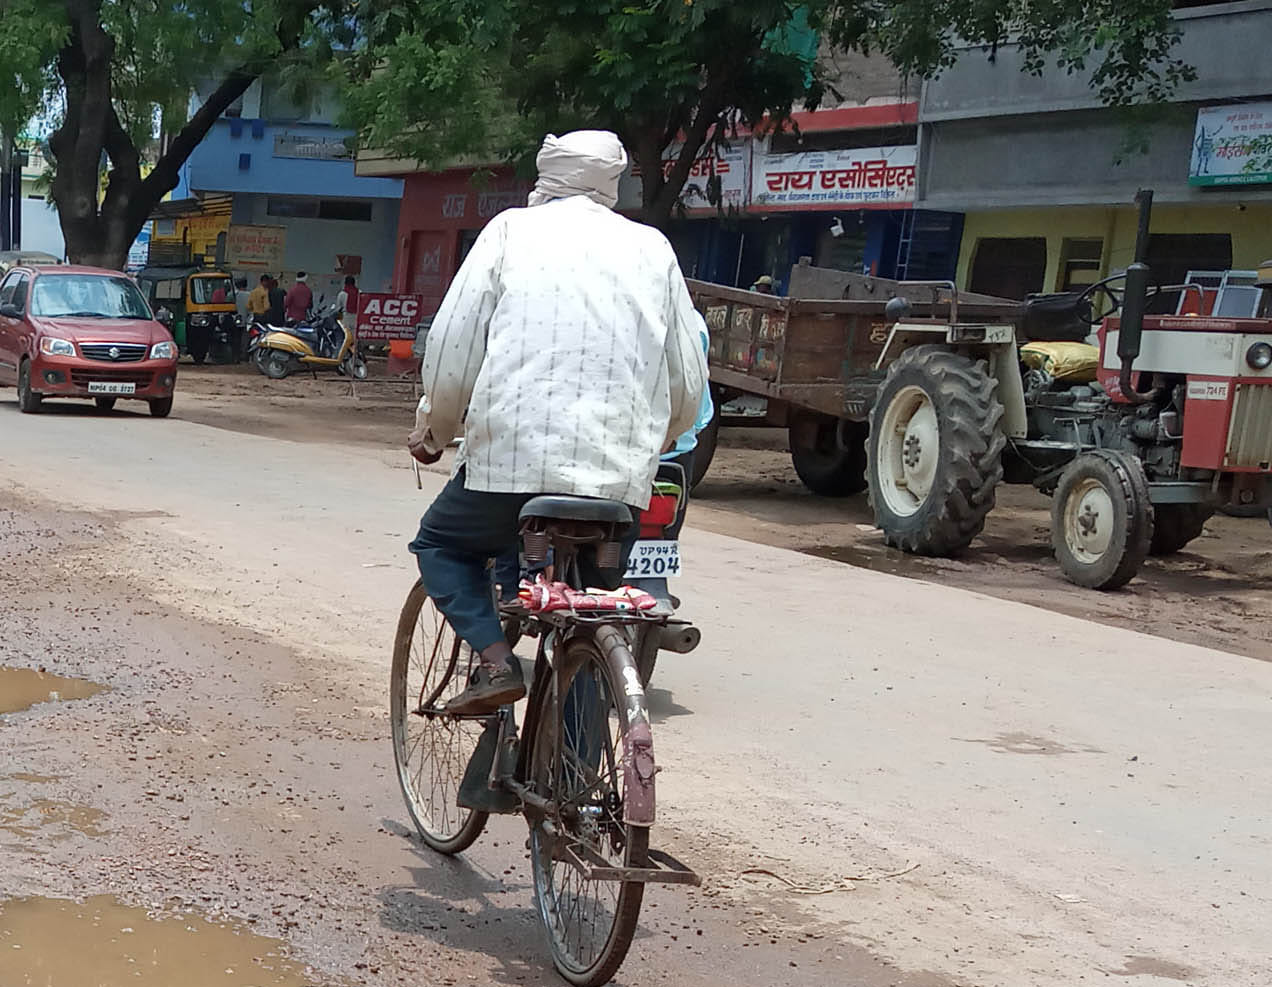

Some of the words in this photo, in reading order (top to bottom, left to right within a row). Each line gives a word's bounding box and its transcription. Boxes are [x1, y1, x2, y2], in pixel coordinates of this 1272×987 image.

[765, 170, 816, 192] राय
[363, 299, 418, 316] ACC
[628, 557, 679, 575] 4204
